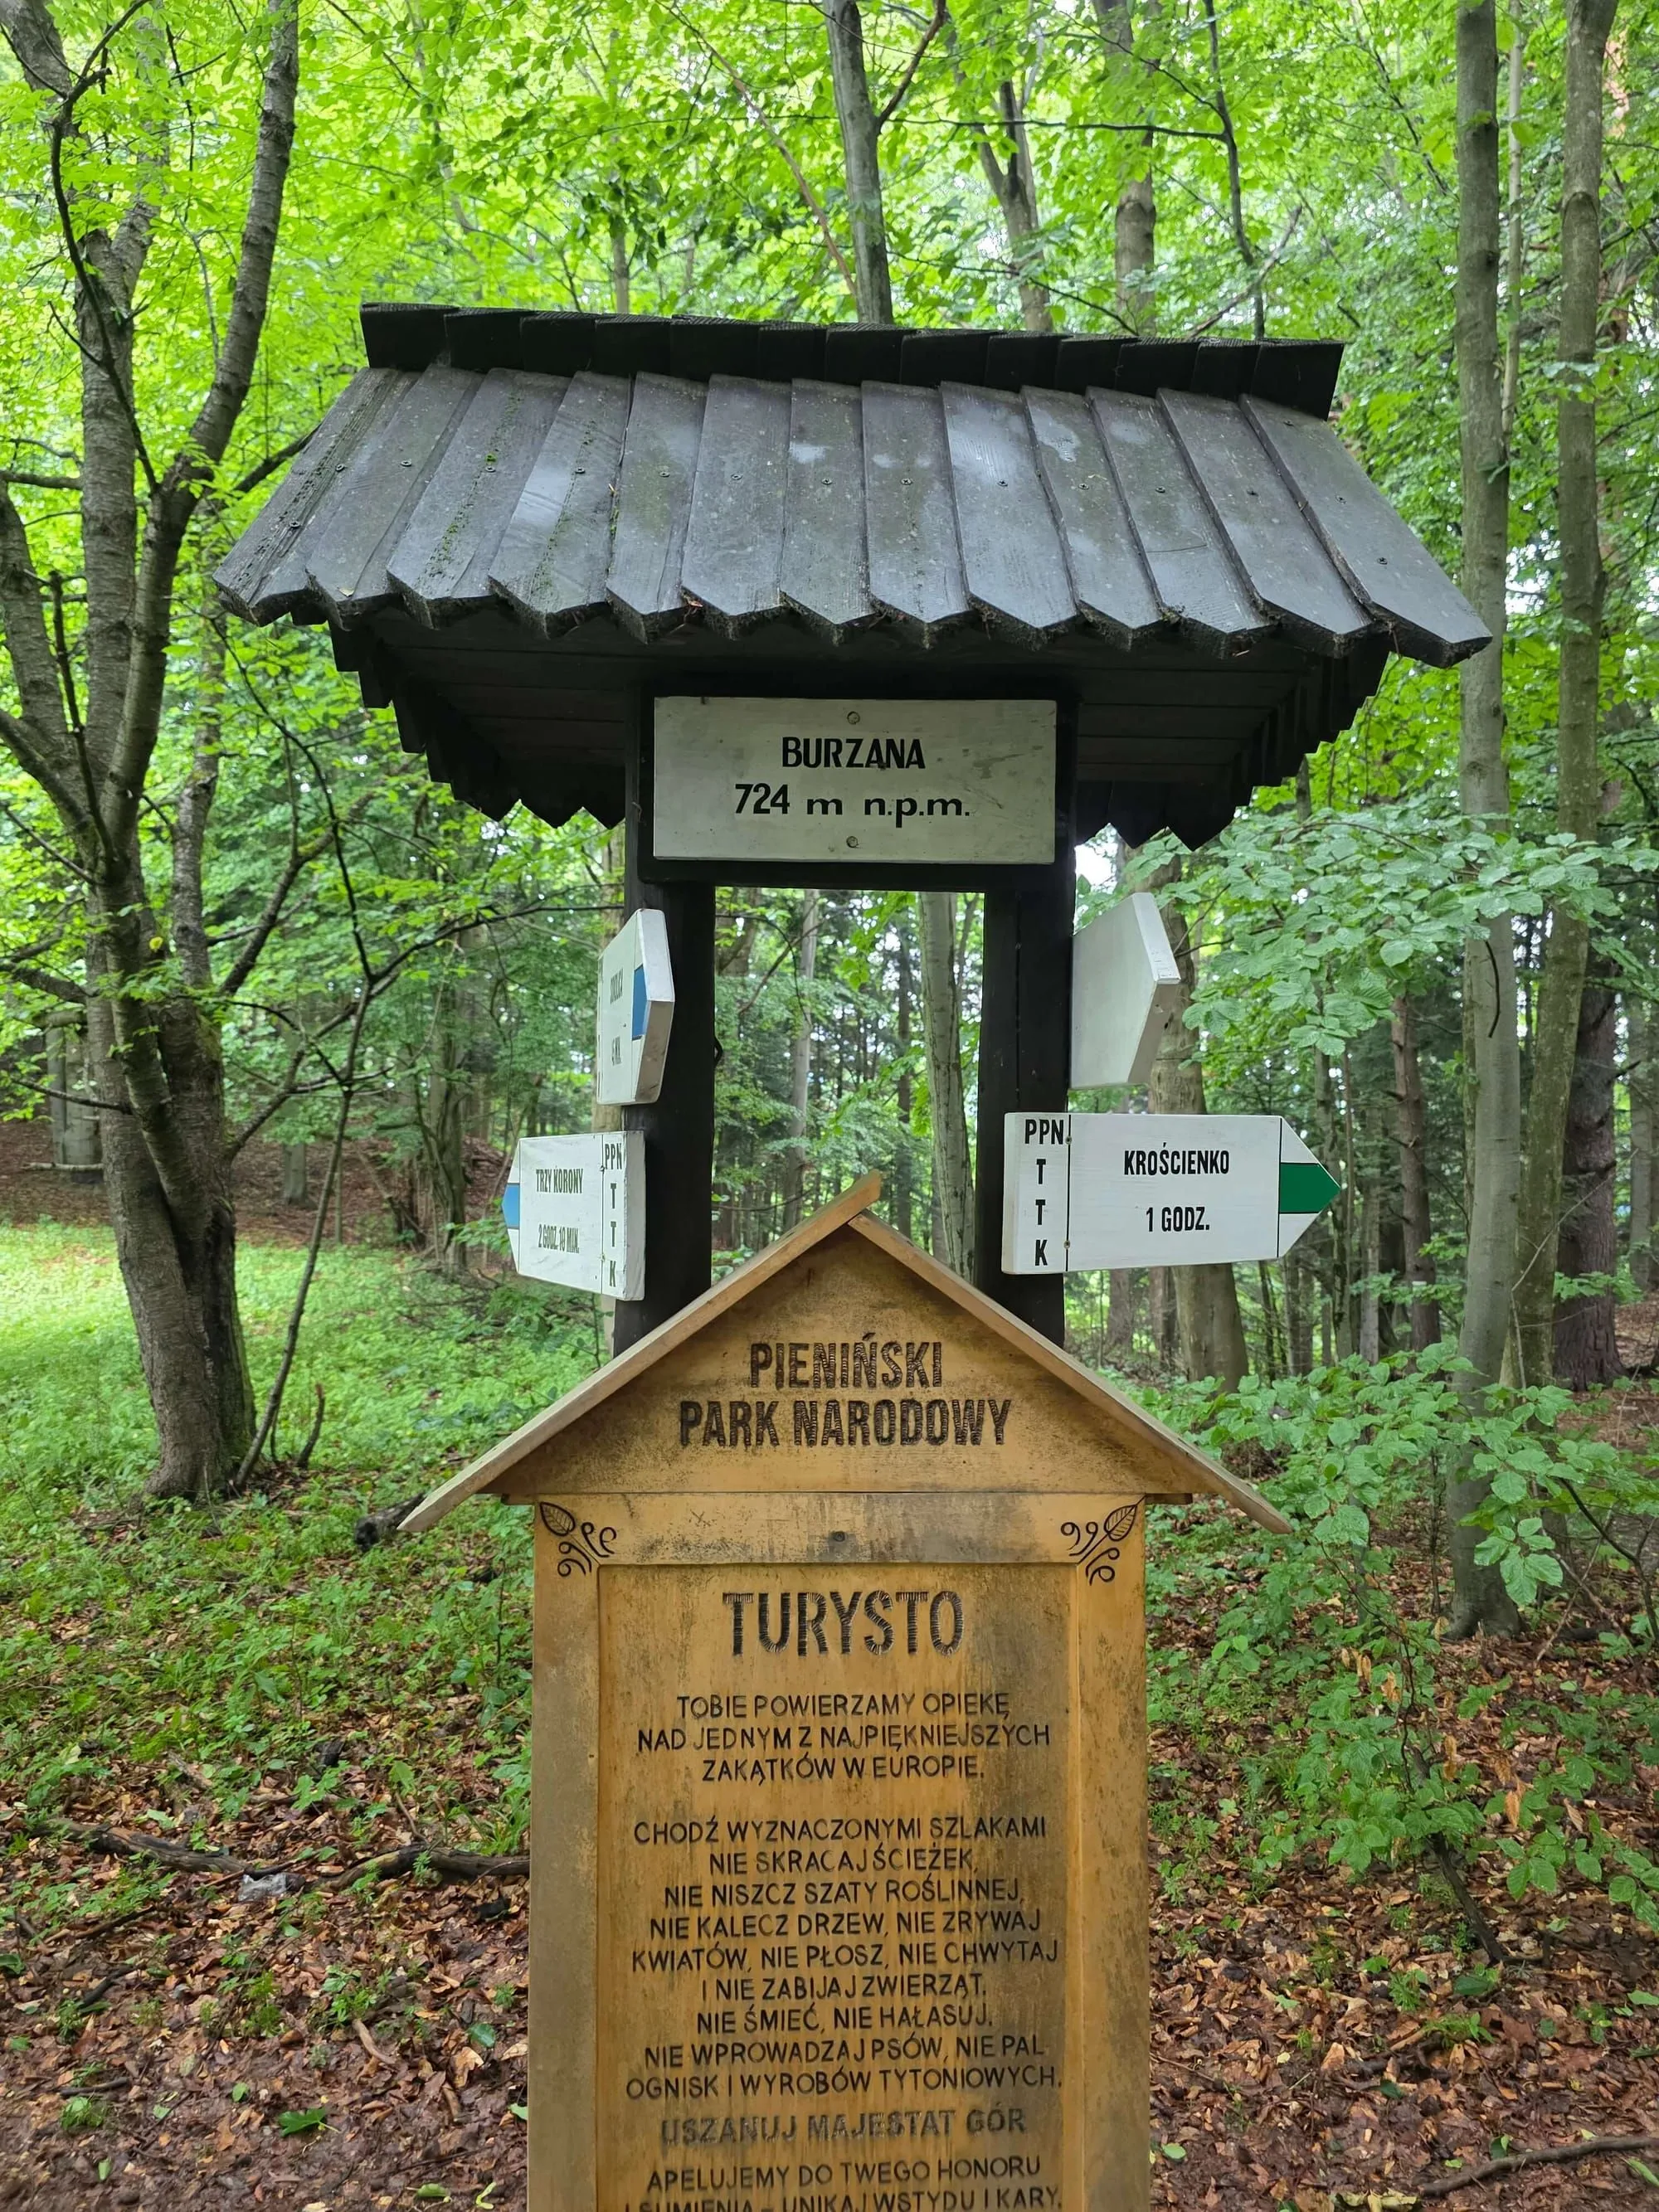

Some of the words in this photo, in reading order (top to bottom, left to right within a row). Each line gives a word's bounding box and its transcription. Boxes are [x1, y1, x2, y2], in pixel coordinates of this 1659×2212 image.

[782, 737, 926, 769] BURZANA
[735, 784, 790, 814] 724
[806, 798, 843, 815] m
[864, 798, 970, 828] n.p.m.
[1024, 1119, 1064, 1145] PPN
[605, 1143, 622, 1169] PPN
[1124, 1142, 1229, 1175] KROŚCIENKO
[536, 1169, 552, 1193] TRZY
[553, 1169, 583, 1194] KORONY
[538, 1224, 542, 1247] 2
[1146, 1208, 1153, 1232] 1
[1161, 1207, 1209, 1232] GODZ.
[749, 1332, 941, 1389] PIENIŃSKI
[679, 1399, 780, 1446] PARK
[793, 1398, 1011, 1446] NARODOWY
[722, 1591, 963, 1656] TURYSTO
[677, 1694, 747, 1719] TOBIE
[753, 1693, 916, 1719] POWIERZAMY
[922, 1692, 1010, 1719] OPIEKĘ
[638, 1728, 686, 1753] NAD
[693, 1726, 791, 1751] JEDNYM
[798, 1725, 812, 1748] Z
[820, 1723, 1049, 1753] NAJPIĘKNIEJSZYCH
[702, 1751, 835, 1786] ZAKĄTKÓW
[843, 1757, 866, 1779] W
[873, 1754, 985, 1779] EUROPIE.
[634, 1815, 718, 1845] CHODŹ
[727, 1816, 922, 1842] WYZNACZONYMI
[930, 1816, 1046, 1839] SZLAKAMI
[709, 1850, 747, 1874] NIE
[756, 1849, 868, 1874] SKRACAJ
[873, 1840, 978, 1873] ŚCIEŻEK,
[664, 1885, 703, 1908] NIE
[711, 1883, 796, 1907] NISZCZ
[804, 1880, 878, 1904] SZATY
[886, 1874, 1025, 1904] ROŚLINNEJ,
[650, 1917, 688, 1940] NIE
[697, 1913, 789, 1938] KALECZ
[797, 1912, 888, 1937] DRZEW,
[897, 1911, 935, 1934] NIE
[941, 1908, 1041, 1932] ZRYWAJ
[631, 1942, 752, 1973] KWIATÓW,
[761, 1945, 799, 1969] NIE
[806, 1943, 889, 1969] PŁOSZ,
[898, 1942, 937, 1966] NIE
[943, 1939, 1058, 1965] CHWYTAJ
[702, 1979, 707, 2002] I
[715, 1976, 754, 2001] NIE
[761, 1975, 857, 2000] ZABIJAJ
[862, 1971, 987, 2001] ZWIERZĄT.
[697, 2011, 736, 2035] NIE
[743, 2002, 825, 2035] ŚMIEĆ,
[833, 2007, 872, 2030] NIE
[879, 2003, 993, 2029] HAŁASUJ.
[645, 2045, 683, 2069] NIE
[691, 2039, 865, 2066] WPROWADZAJ
[871, 2032, 949, 2063] PSÓW,
[956, 2035, 995, 2059] NIE
[1002, 2034, 1044, 2057] PAL
[626, 2074, 718, 2100] OGNISK
[727, 2073, 732, 2097] I
[740, 2069, 871, 2097] WYROBÓW
[879, 2066, 1062, 2091] TYTONIOWYCH.
[661, 2114, 797, 2146] USZANUJ
[807, 2109, 956, 2141] MAJESTAT
[966, 2103, 1027, 2134] GÓR
[647, 2166, 790, 2192] APELUJEMY
[799, 2164, 833, 2187] DO
[840, 2160, 930, 2185] TWEGO
[938, 2155, 1040, 2182] HONORU
[873, 2189, 975, 2212] WSTYDU
[985, 2188, 989, 2209] I
[997, 2185, 1062, 2210] KARY.
